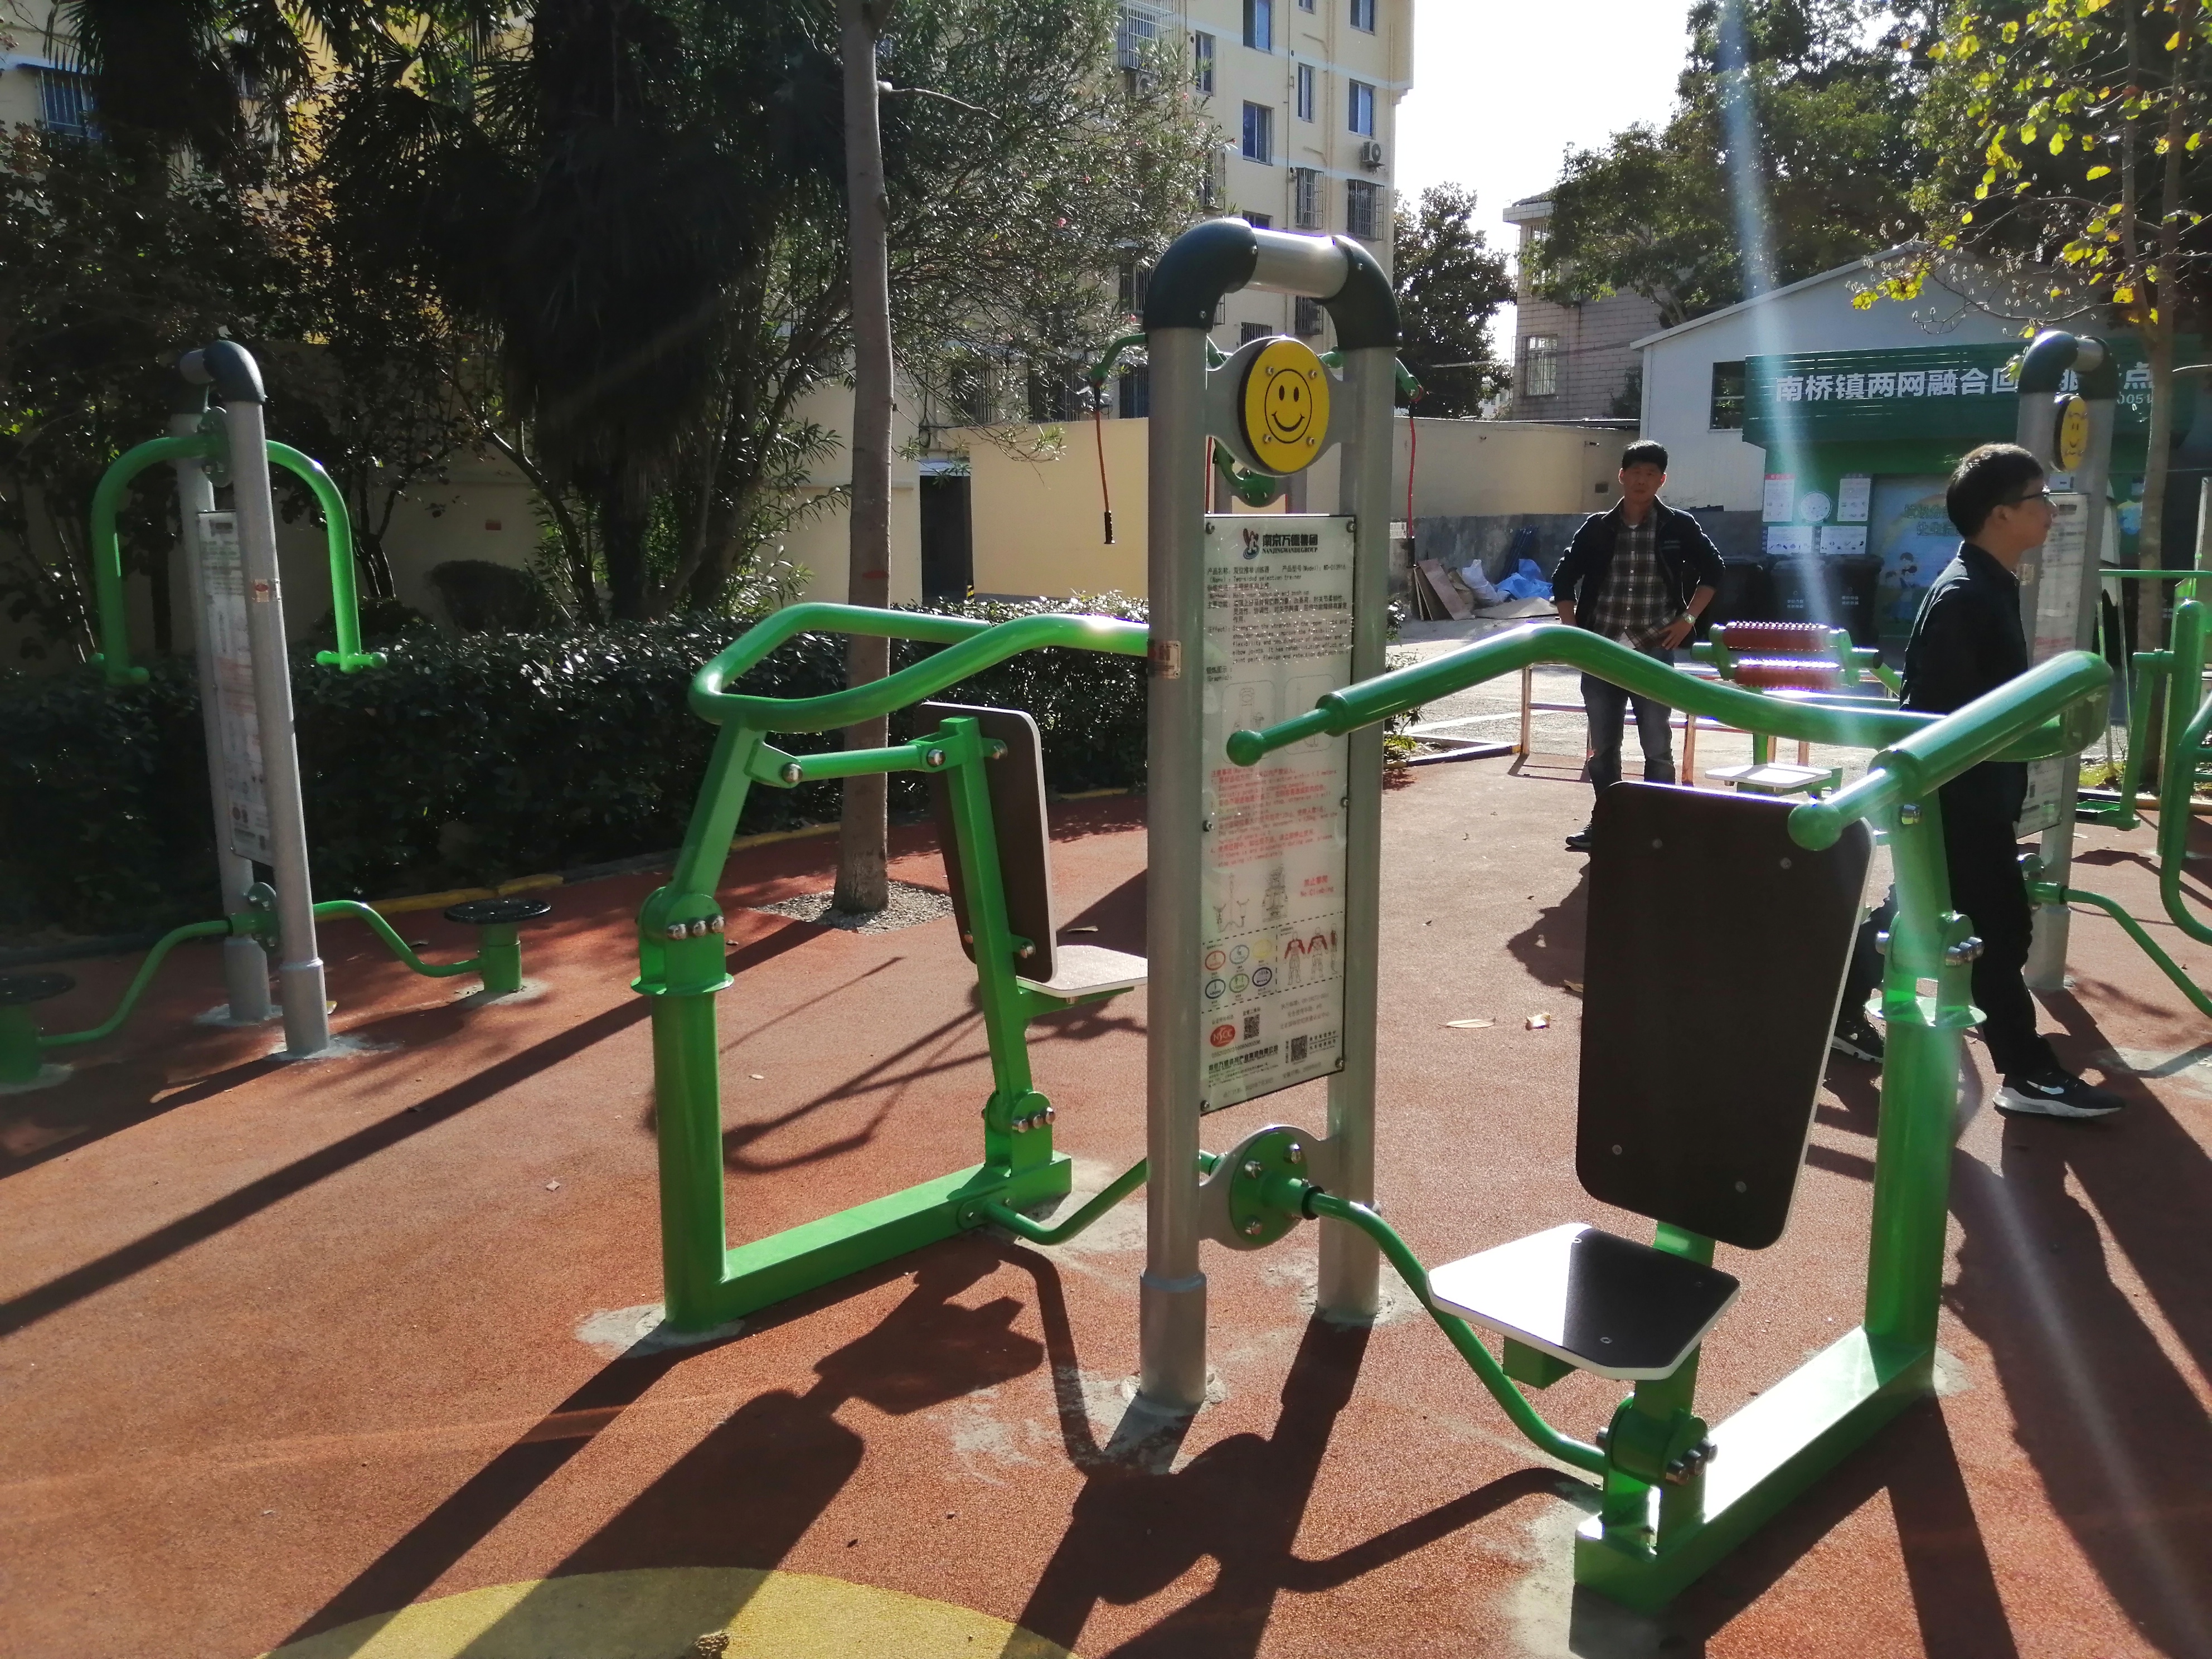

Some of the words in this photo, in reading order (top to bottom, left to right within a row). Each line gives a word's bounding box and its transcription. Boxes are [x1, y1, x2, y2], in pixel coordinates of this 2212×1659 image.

[1263, 533, 1318, 547] 南京万德集团
